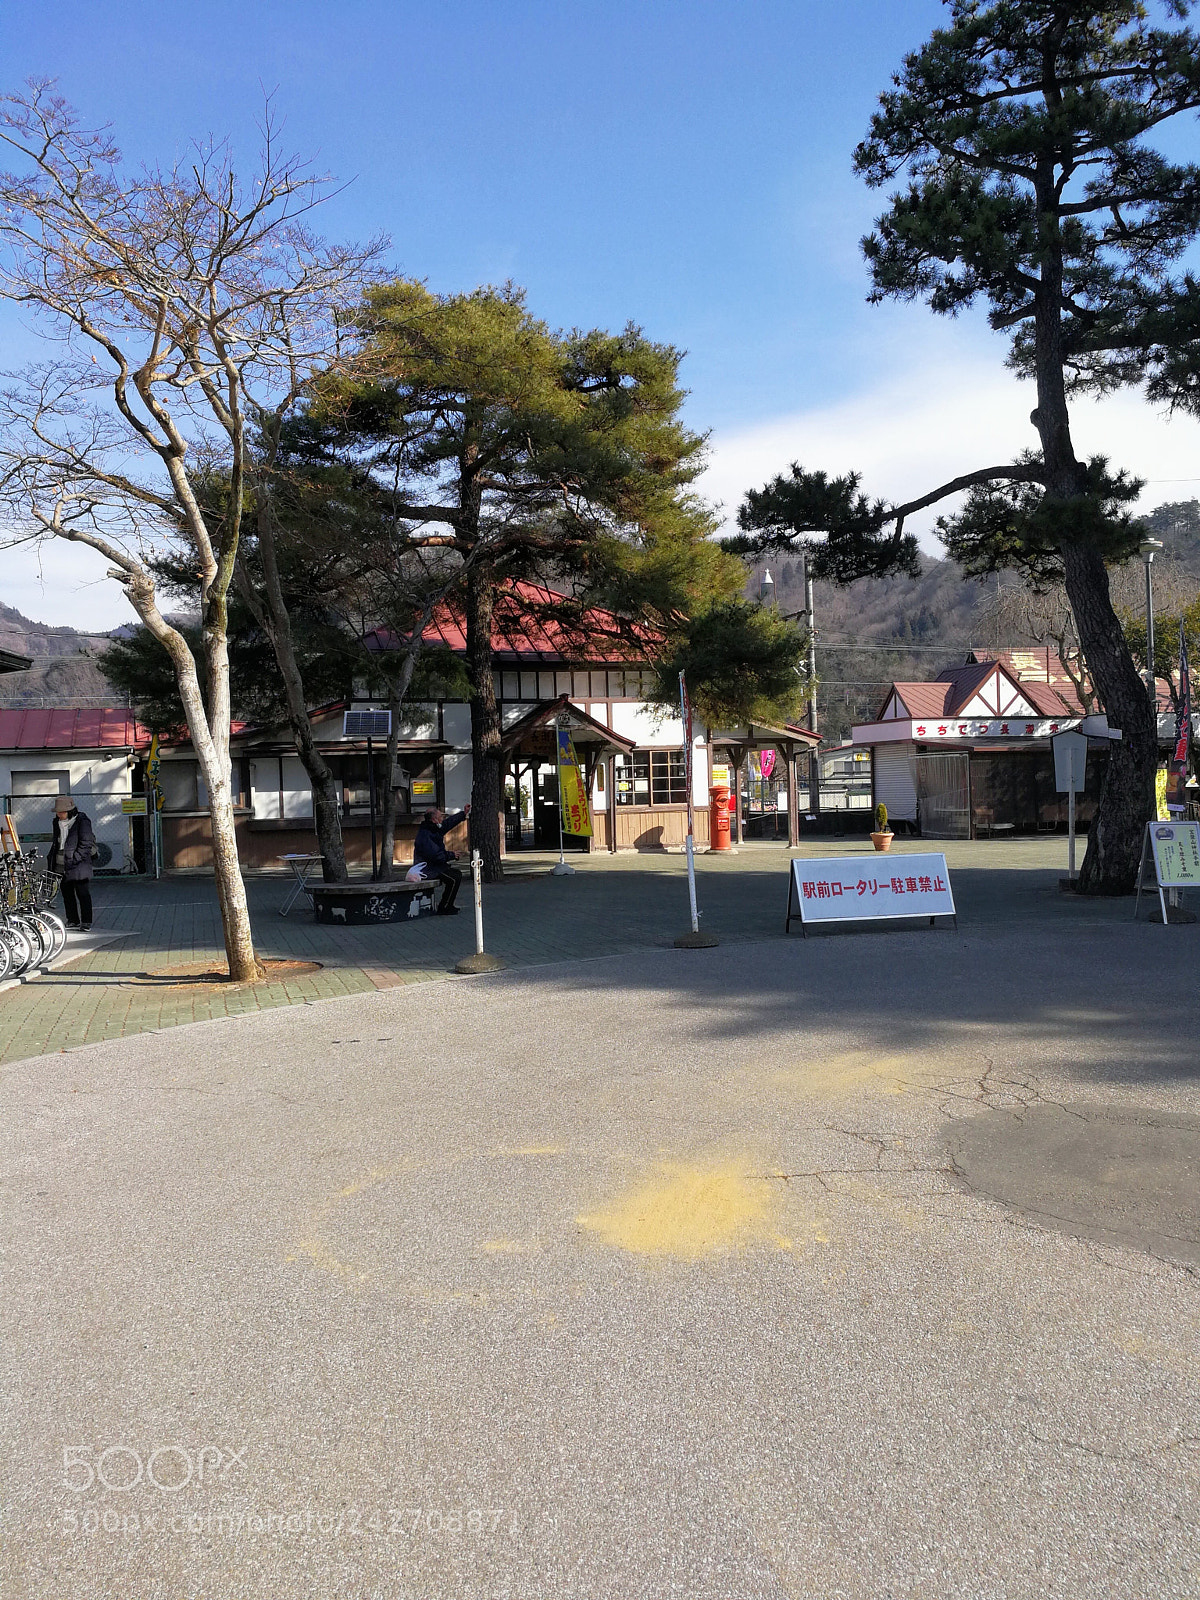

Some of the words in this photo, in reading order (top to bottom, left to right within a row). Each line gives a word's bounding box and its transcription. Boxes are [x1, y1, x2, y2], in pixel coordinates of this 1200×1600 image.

[803, 876, 946, 899] 駅前ロータリー駐車禁止
